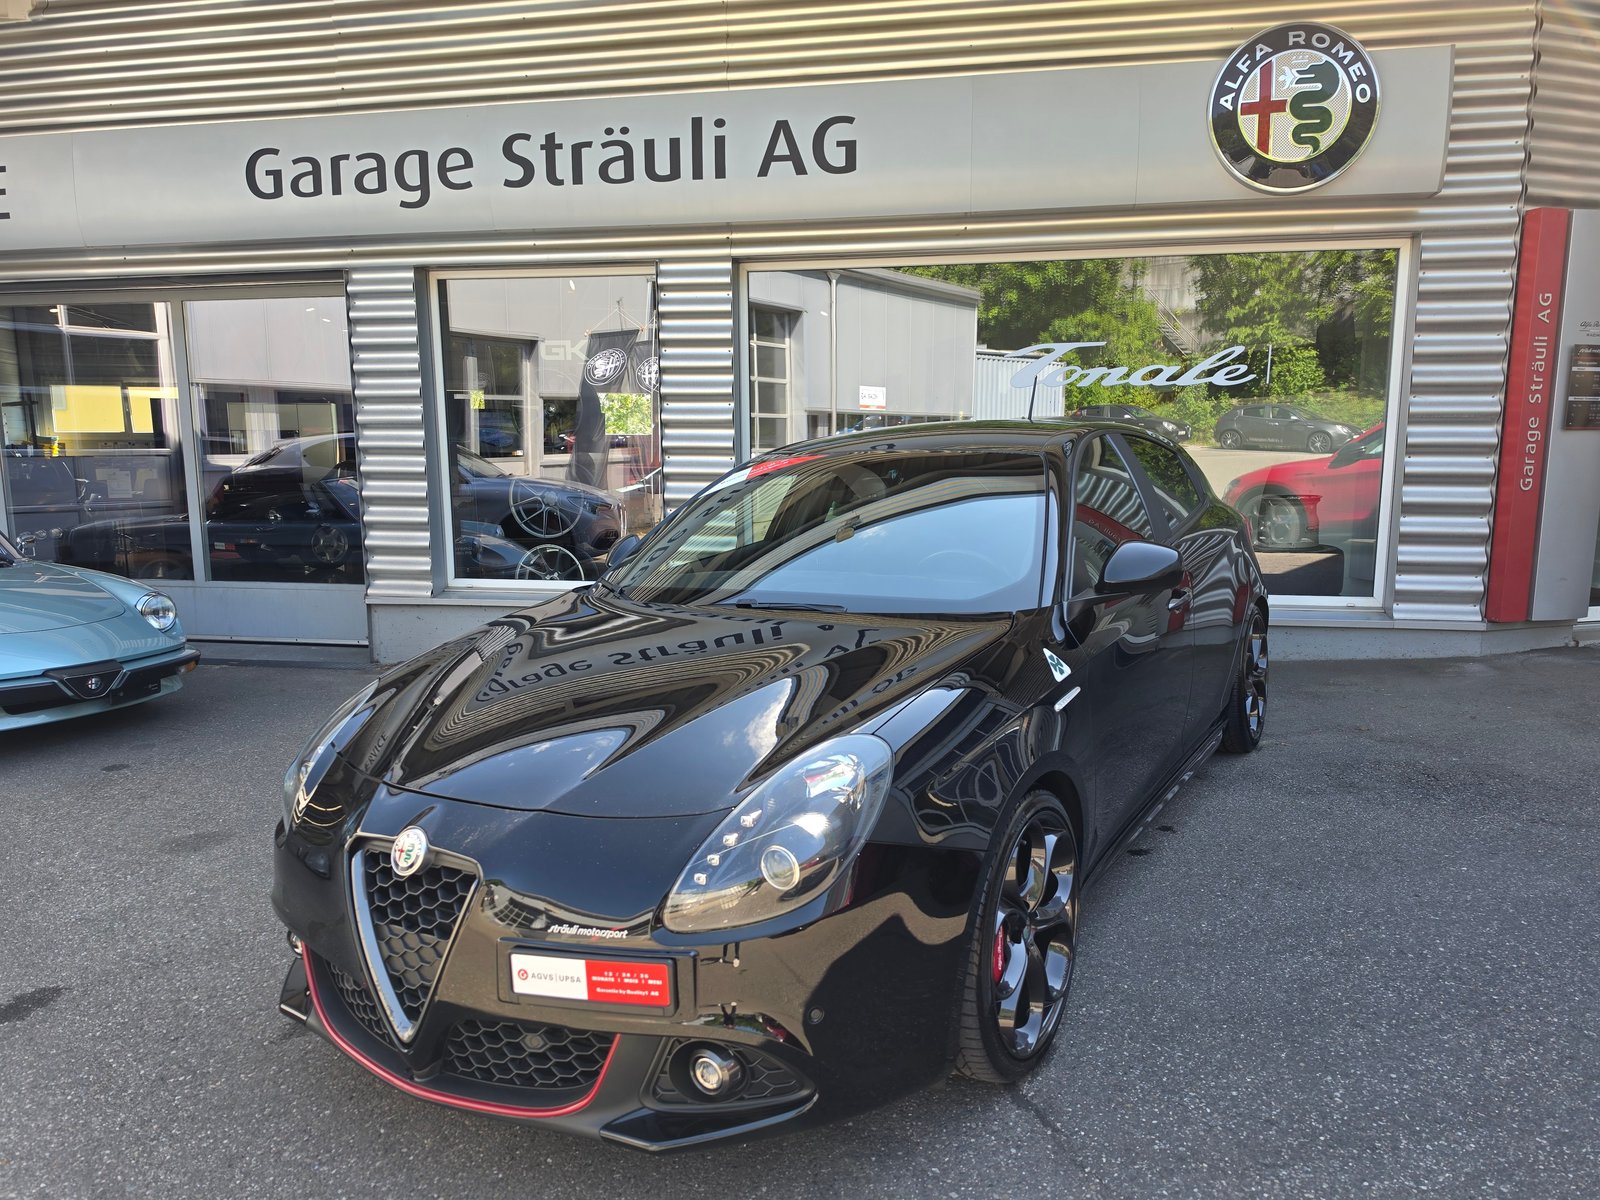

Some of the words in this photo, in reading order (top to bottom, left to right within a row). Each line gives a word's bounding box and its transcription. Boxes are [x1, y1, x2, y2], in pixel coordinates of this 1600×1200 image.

[1219, 43, 1274, 111] ALFA
[1288, 31, 1371, 103] ROMEO
[245, 146, 475, 210] Garage
[502, 115, 728, 188] Sträuli
[757, 114, 858, 178] AG
[1537, 292, 1552, 323] AG
[1003, 341, 1257, 388] Tonale
[1529, 336, 1548, 404] Sträuli
[1520, 416, 1541, 491] Garage
[577, 927, 628, 939] motorsport
